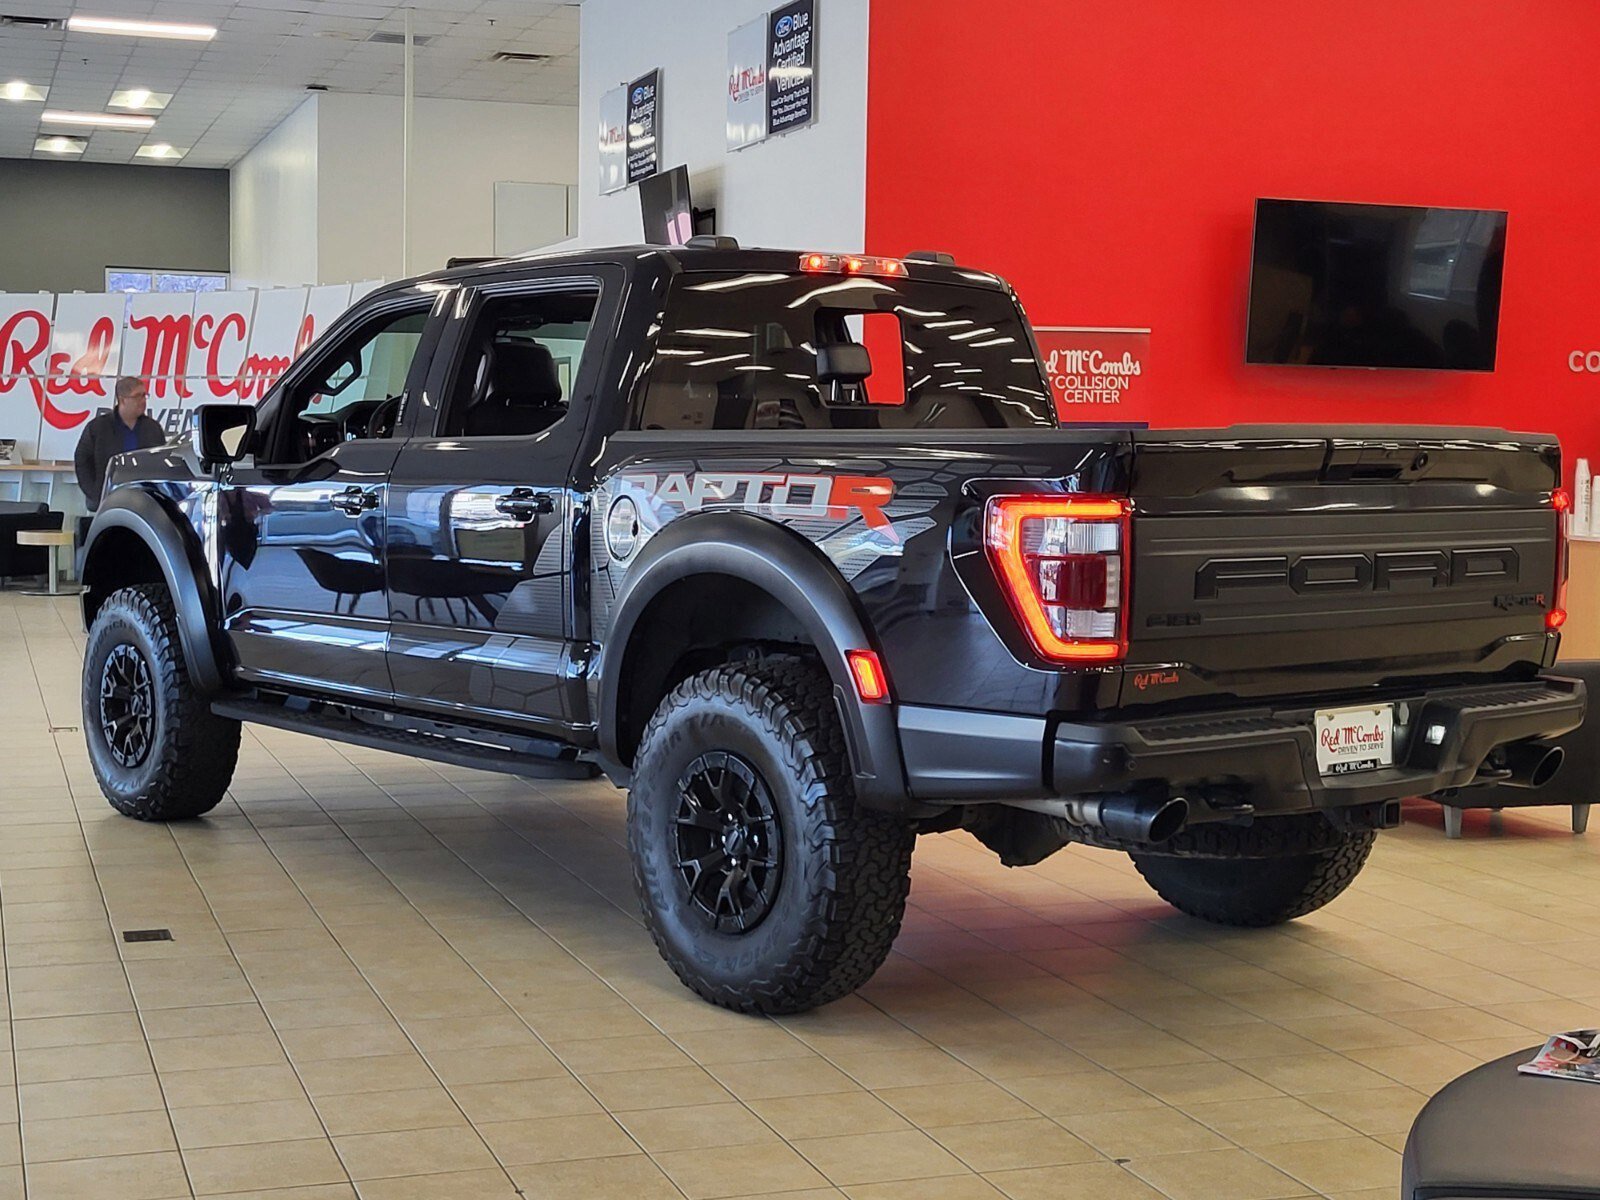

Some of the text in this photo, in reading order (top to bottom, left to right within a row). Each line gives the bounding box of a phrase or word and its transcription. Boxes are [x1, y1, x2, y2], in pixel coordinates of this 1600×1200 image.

[793, 12, 808, 31] Blue
[1060, 349, 1141, 375] McCombs
[1055, 375, 1129, 390] COLLISION
[1064, 389, 1120, 404] CENTER
[620, 471, 901, 545] RAPTOR
[1194, 547, 1520, 601] FORD
[1321, 724, 1384, 753] Red McCombs
[1337, 742, 1384, 755] DRIVEN TO SERVE
